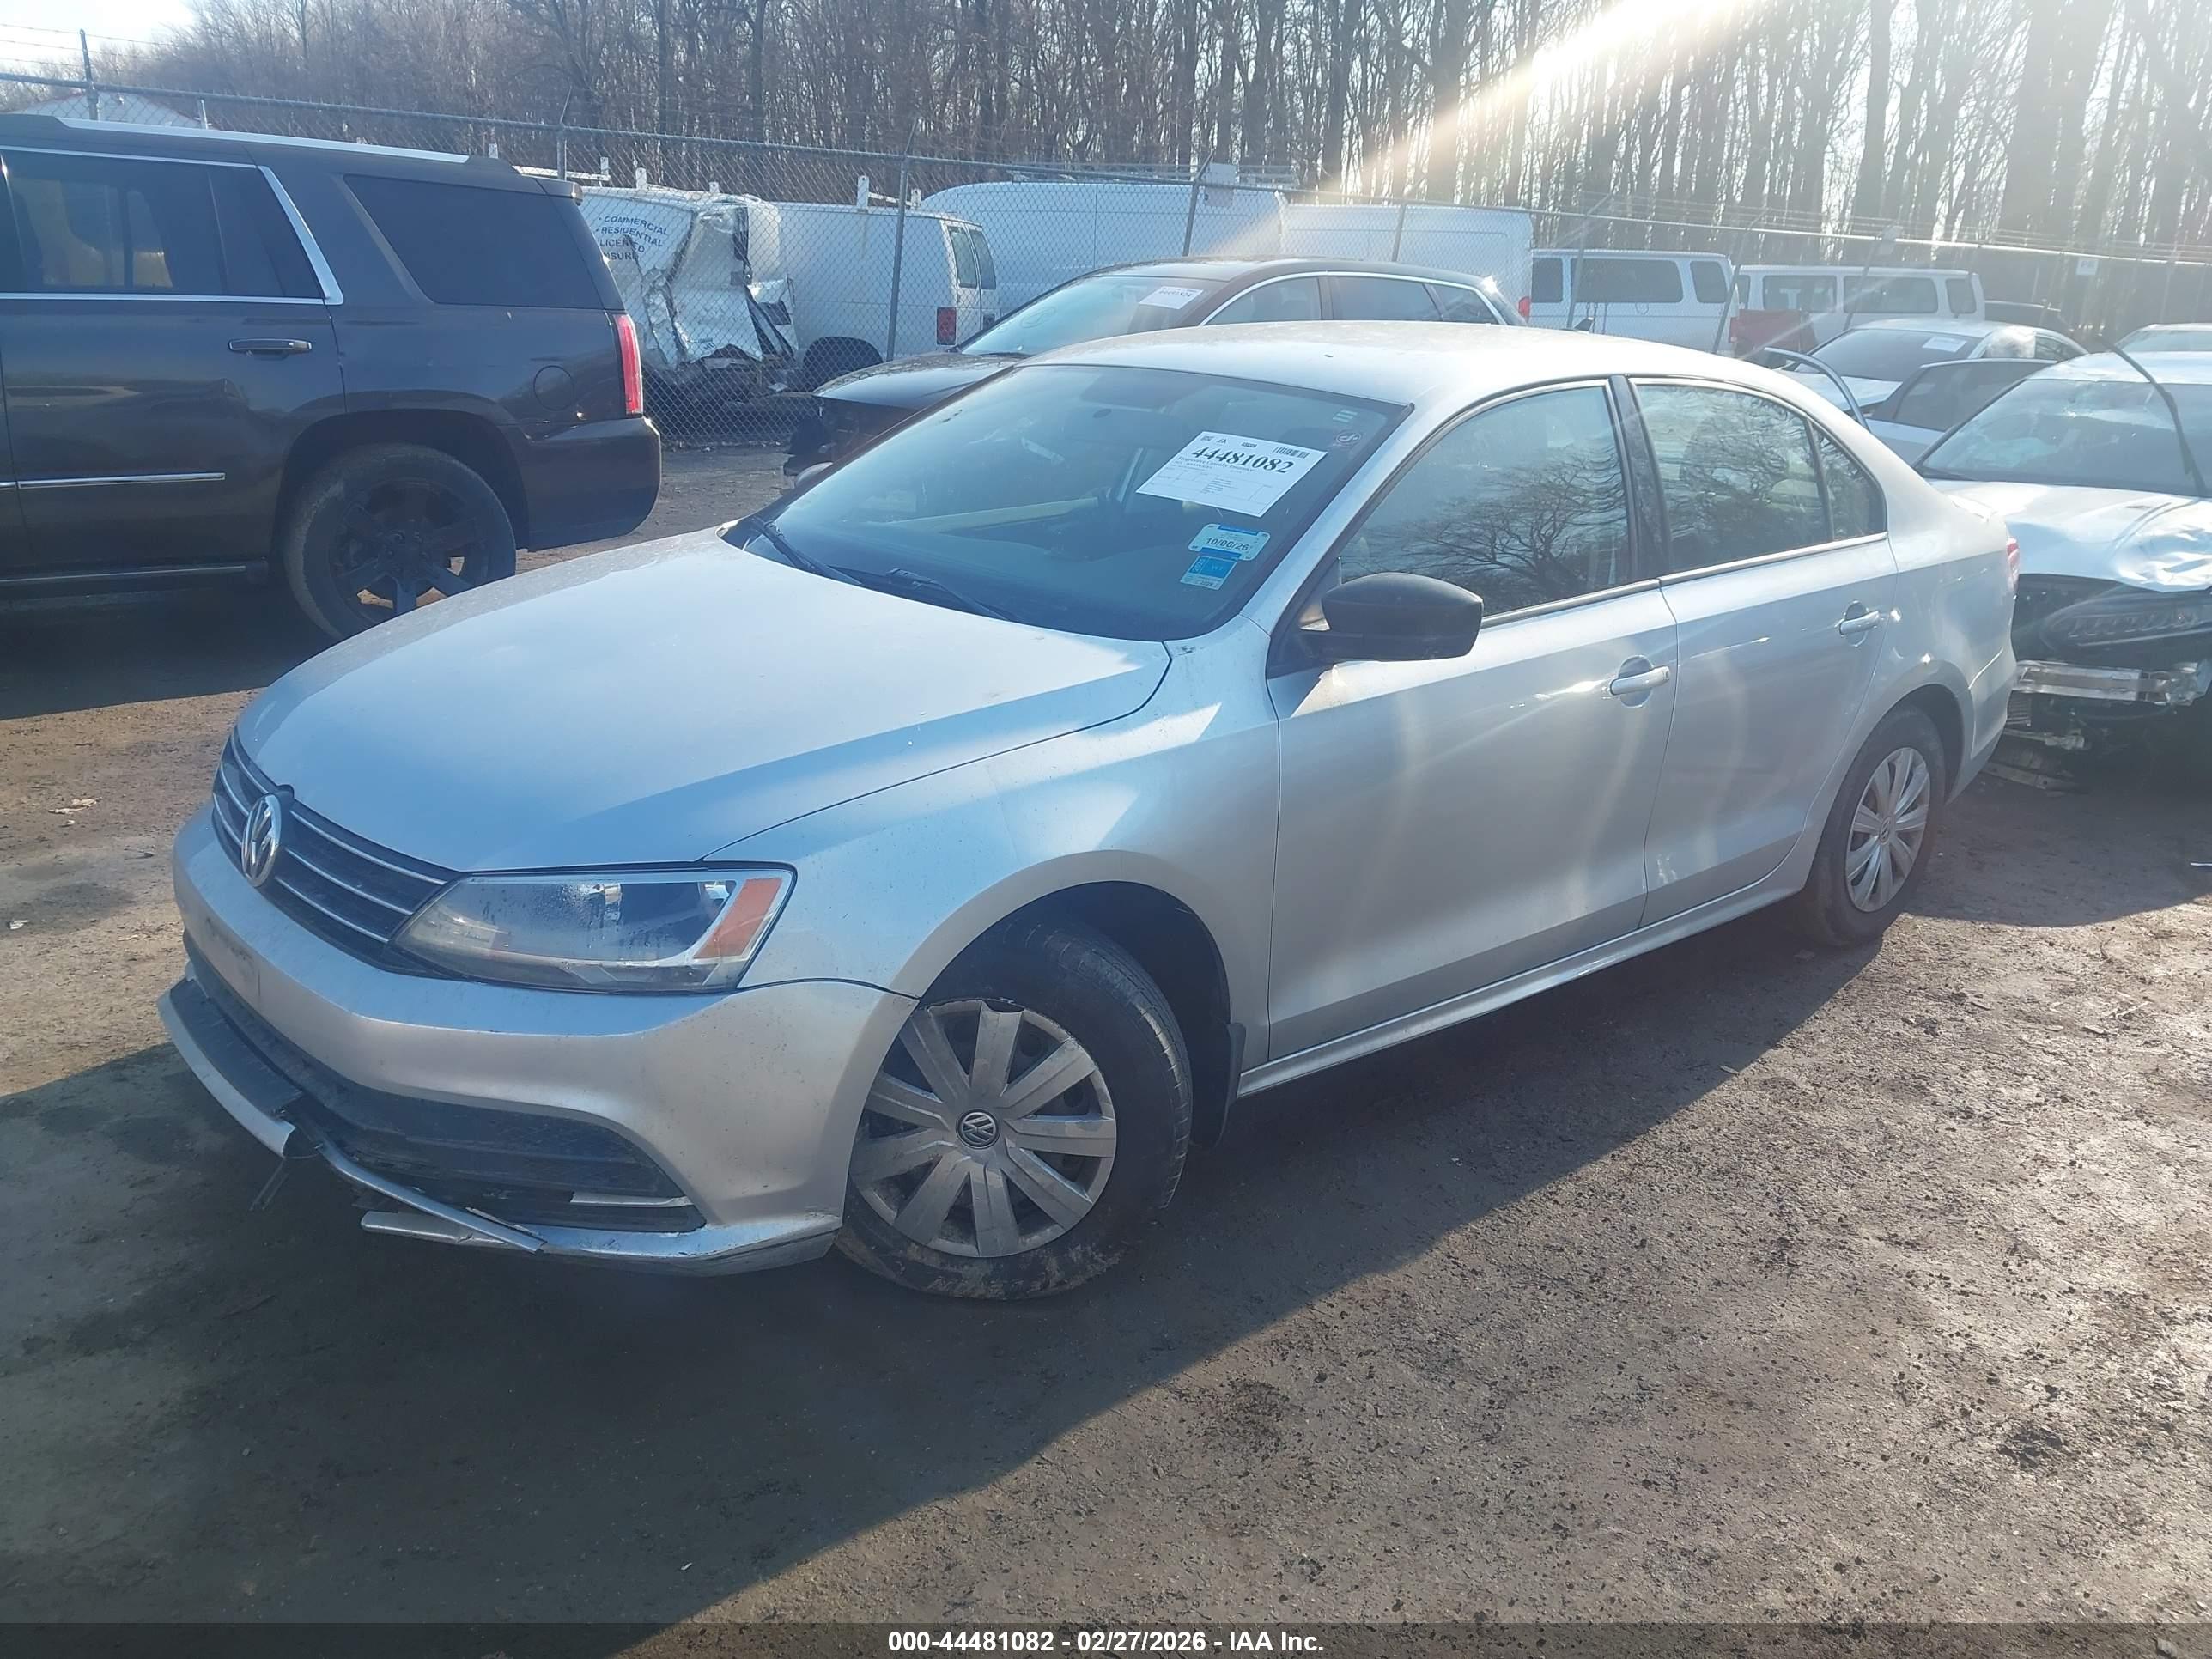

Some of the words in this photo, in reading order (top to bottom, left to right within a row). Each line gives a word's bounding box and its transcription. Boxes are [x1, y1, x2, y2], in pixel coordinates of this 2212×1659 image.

[604, 216, 667, 235] COMMERCIAL
[599, 238, 645, 253] LICENED
[601, 226, 664, 247] RESIDENTIAL
[1192, 447, 1294, 474] 44481082
[1206, 537, 1249, 552] 10/06/26
